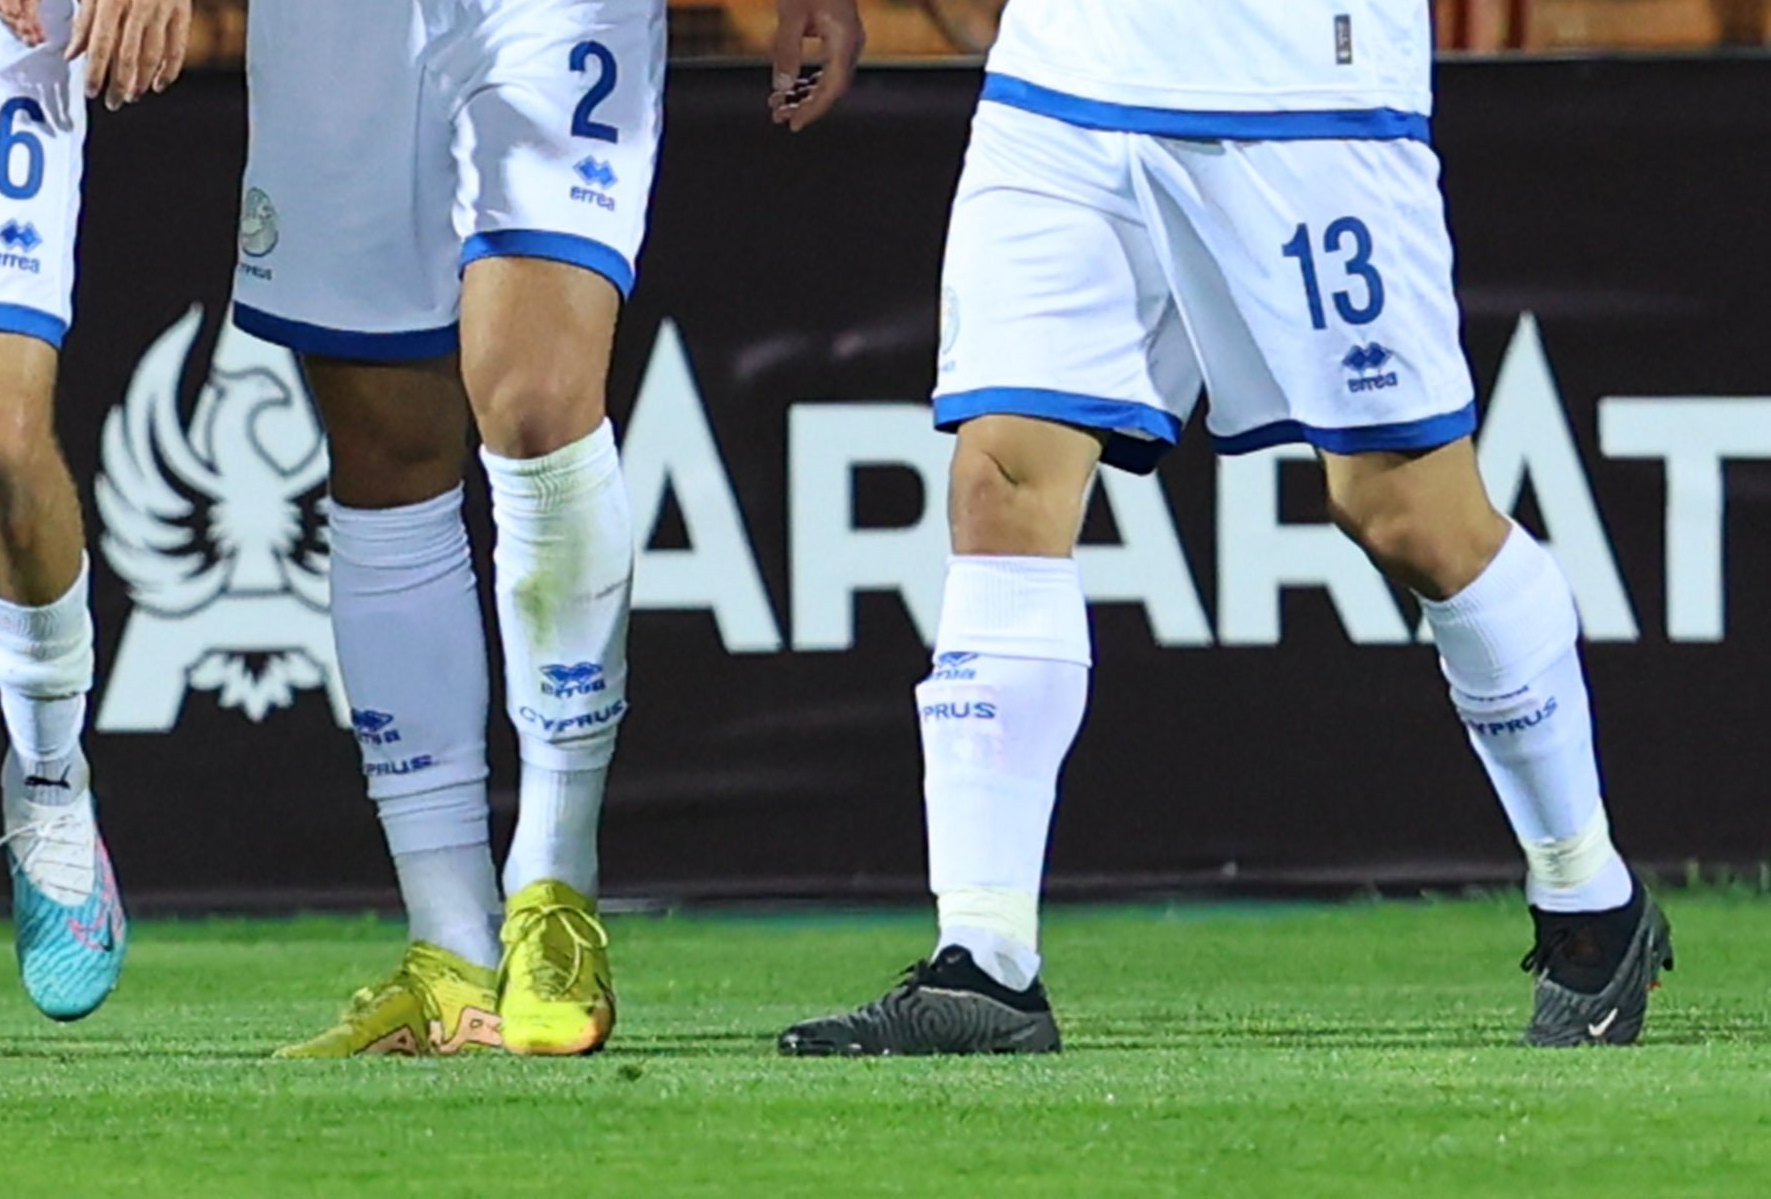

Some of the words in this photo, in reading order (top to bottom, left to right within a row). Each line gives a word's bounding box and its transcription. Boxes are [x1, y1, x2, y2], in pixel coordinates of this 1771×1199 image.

[568, 40, 618, 144] 2
[238, 262, 273, 281] YPRUS
[1281, 216, 1386, 331] 13
[519, 699, 625, 732] CYPRUS
[923, 702, 997, 721] PRUS
[1467, 696, 1558, 736] YPRUS
[363, 755, 433, 776] PRUS
